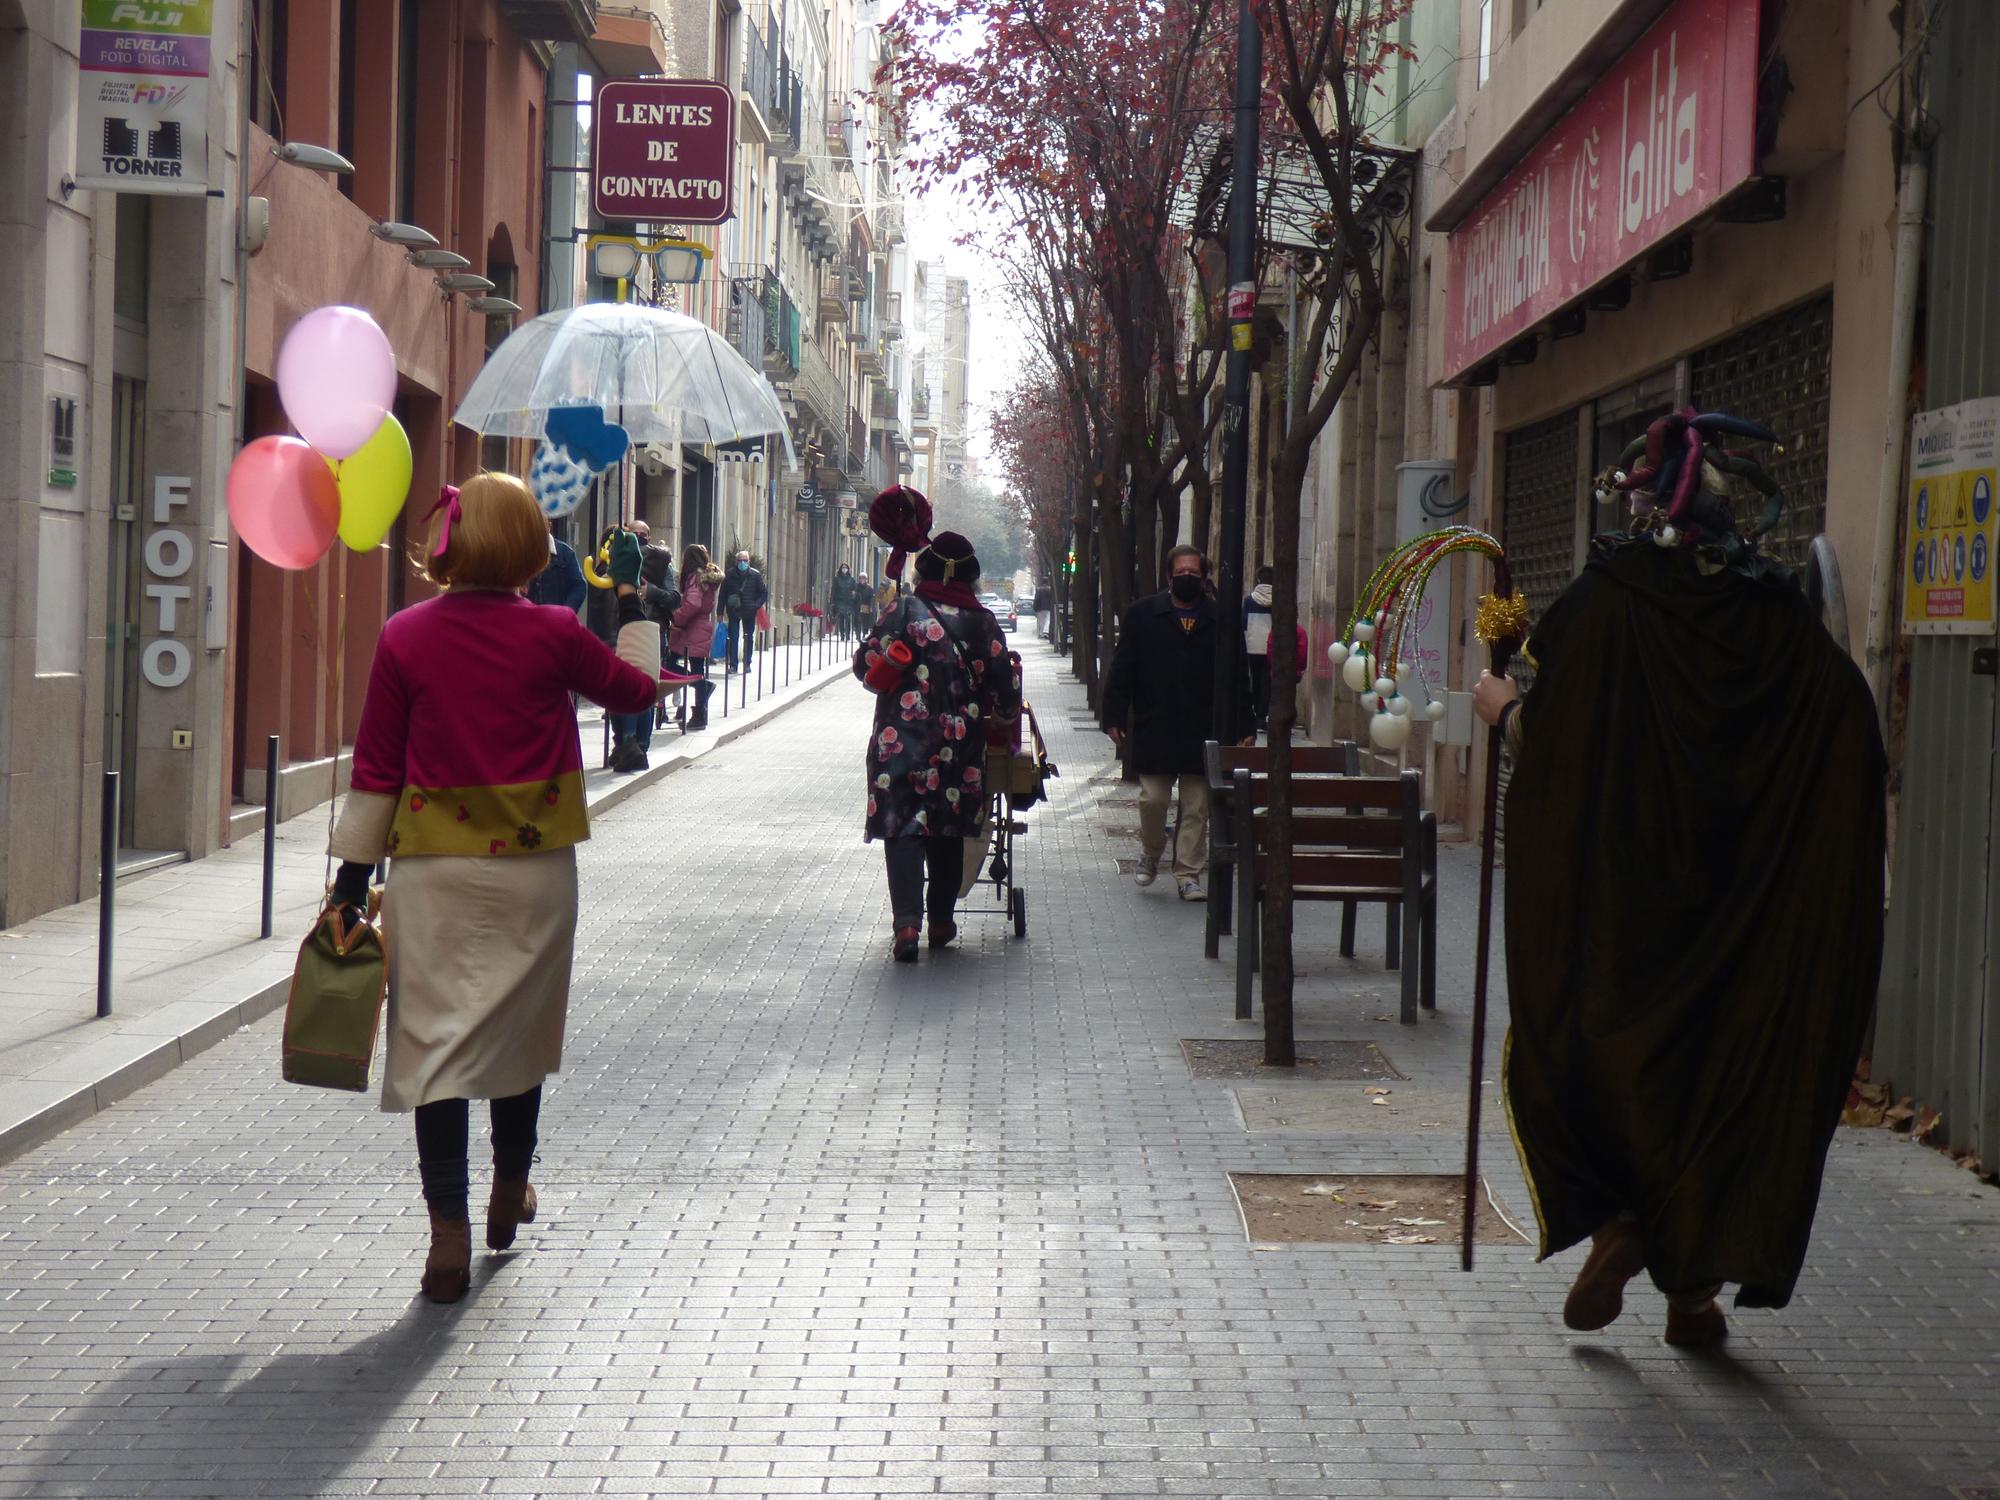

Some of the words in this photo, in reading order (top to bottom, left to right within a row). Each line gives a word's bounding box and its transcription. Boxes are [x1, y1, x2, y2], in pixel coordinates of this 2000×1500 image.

[111, 5, 184, 26] FUJI
[115, 37, 177, 53] REVELAT
[100, 50, 132, 63] FOTO
[137, 53, 188, 67] DIGITAL
[615, 103, 713, 126] LENTES
[1618, 30, 1697, 242] lolita
[647, 140, 679, 162] DE
[102, 156, 182, 177] TORNER
[601, 176, 723, 200] CONTACTO
[142, 475, 194, 688] FOTO
